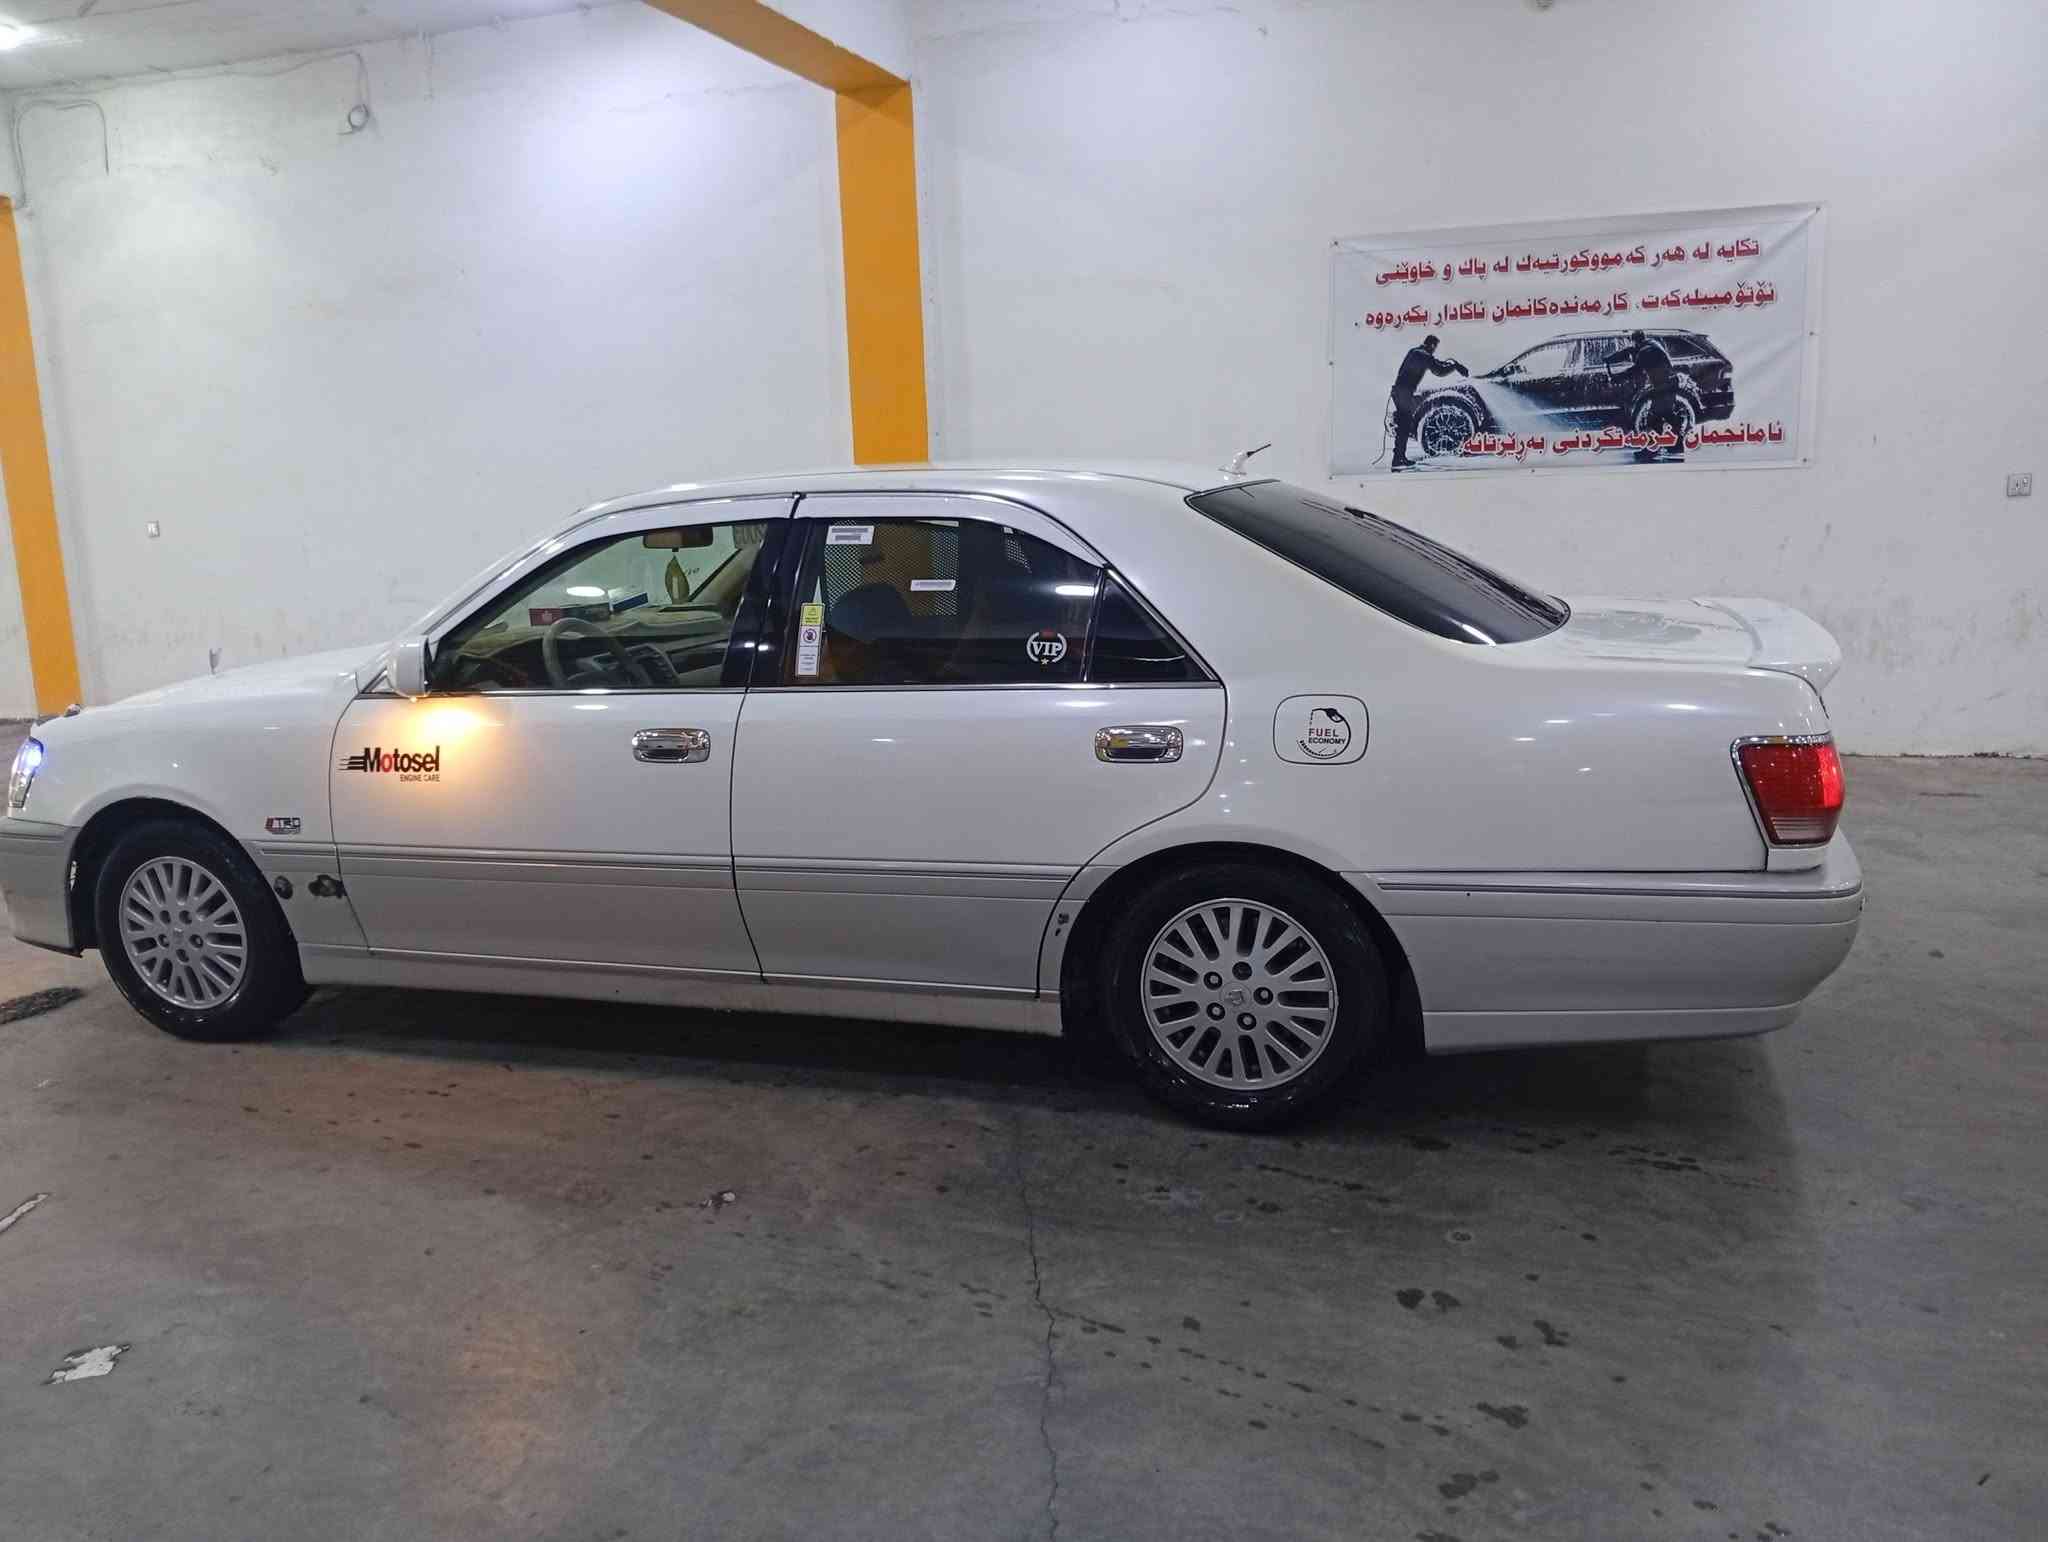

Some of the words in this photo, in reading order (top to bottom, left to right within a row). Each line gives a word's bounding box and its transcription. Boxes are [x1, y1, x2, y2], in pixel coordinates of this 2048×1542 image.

[1442, 263, 1452, 281] و
[1031, 641, 1063, 656] VIP
[1308, 728, 1339, 737] FUEL
[1308, 737, 1346, 745] ECONOMY
[363, 745, 440, 773] Motosel
[399, 774, 422, 782] ENGINE
[424, 774, 440, 782] CARE
